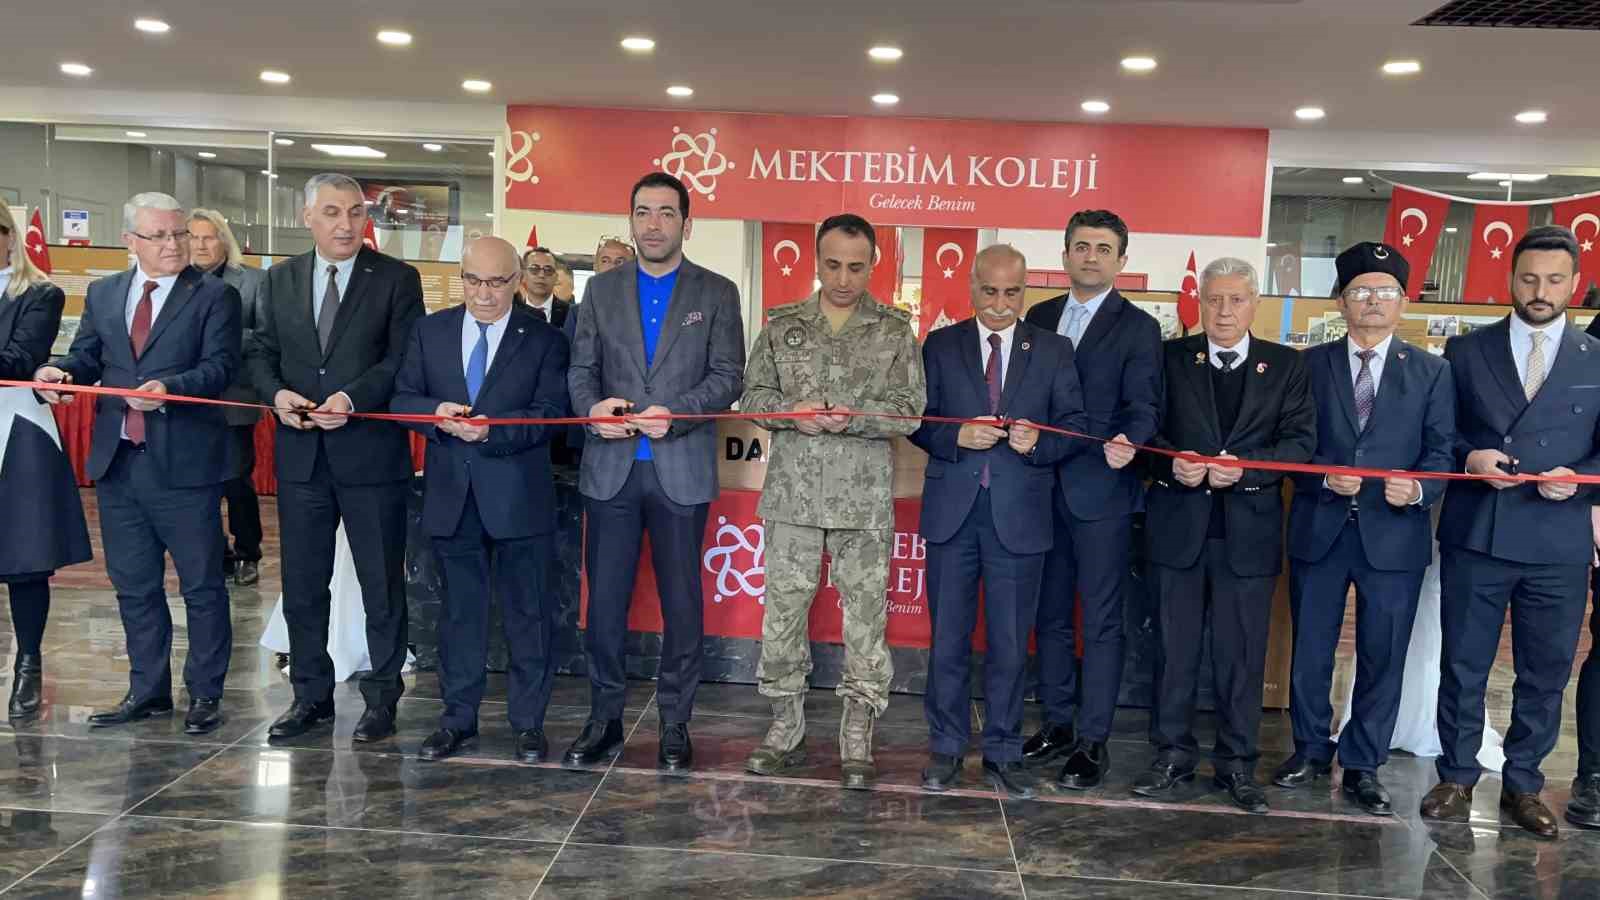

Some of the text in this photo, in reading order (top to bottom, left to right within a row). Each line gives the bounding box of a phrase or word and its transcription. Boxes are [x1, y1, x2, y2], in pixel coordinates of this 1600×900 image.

[747, 145, 1099, 198] MEKTEBİM KOLEJİ
[869, 192, 976, 213] Gelecek Benim
